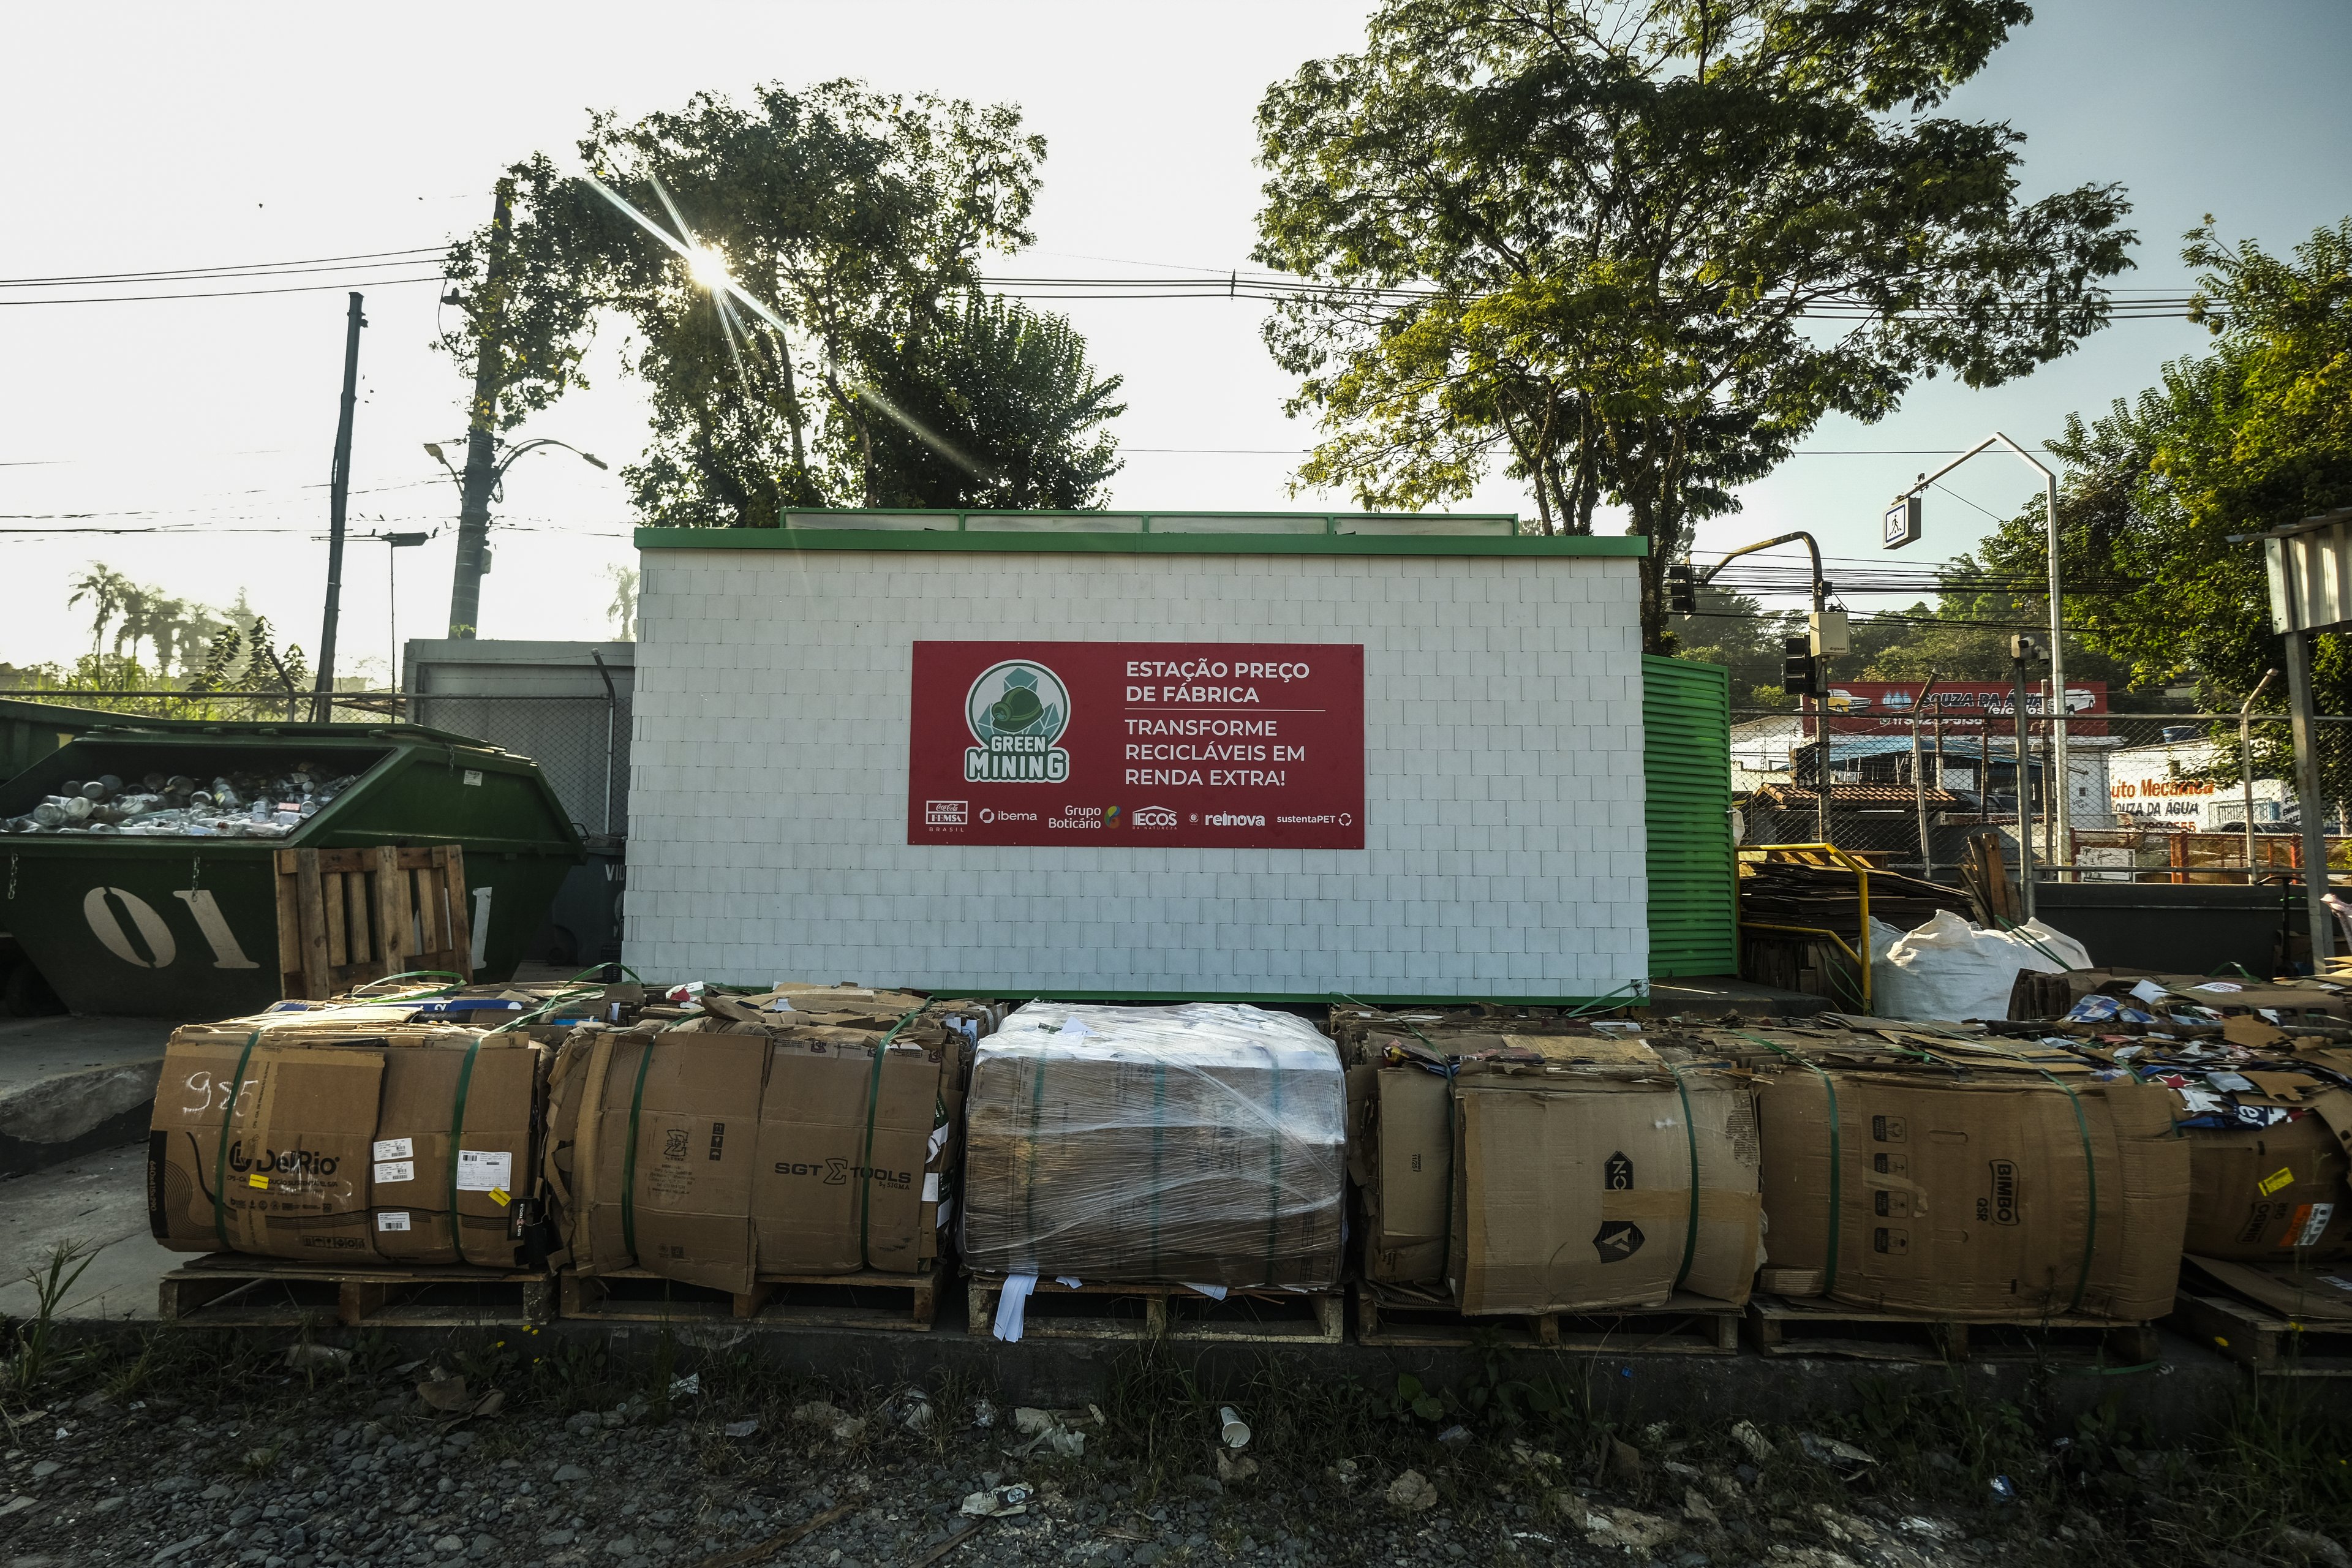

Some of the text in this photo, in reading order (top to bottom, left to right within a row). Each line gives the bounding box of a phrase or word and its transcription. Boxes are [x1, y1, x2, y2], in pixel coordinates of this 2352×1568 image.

[1126, 658, 1310, 683] ESTAÇÃO PREÇO
[1126, 681, 1259, 703] DE FÁBRICA
[1921, 693, 1973, 708] SOUZA
[2004, 688, 2043, 707] ÁUA
[1125, 719, 1277, 737] TRANSFORME
[992, 736, 1045, 752] GREEN
[1126, 739, 1305, 761] RECICLÁVEIS EM
[968, 753, 1065, 779] MINING
[1126, 769, 1286, 786] RENDA EXTRA!
[2112, 780, 2135, 797] uto
[998, 810, 1038, 821] ibema
[1065, 805, 1101, 816] Grupo
[2116, 799, 2200, 816] OUZA DA ÁGUA
[1049, 817, 1101, 829] Boticário
[1205, 810, 1265, 826] reinova
[1276, 815, 1336, 824] sustentaPET
[83, 887, 260, 968] 01
[257, 1150, 337, 1175] DelRio
[774, 1162, 911, 1183] SGT TOOLS
[1997, 1164, 2012, 1221] BIMBO
[1977, 1197, 1988, 1221] QSR
